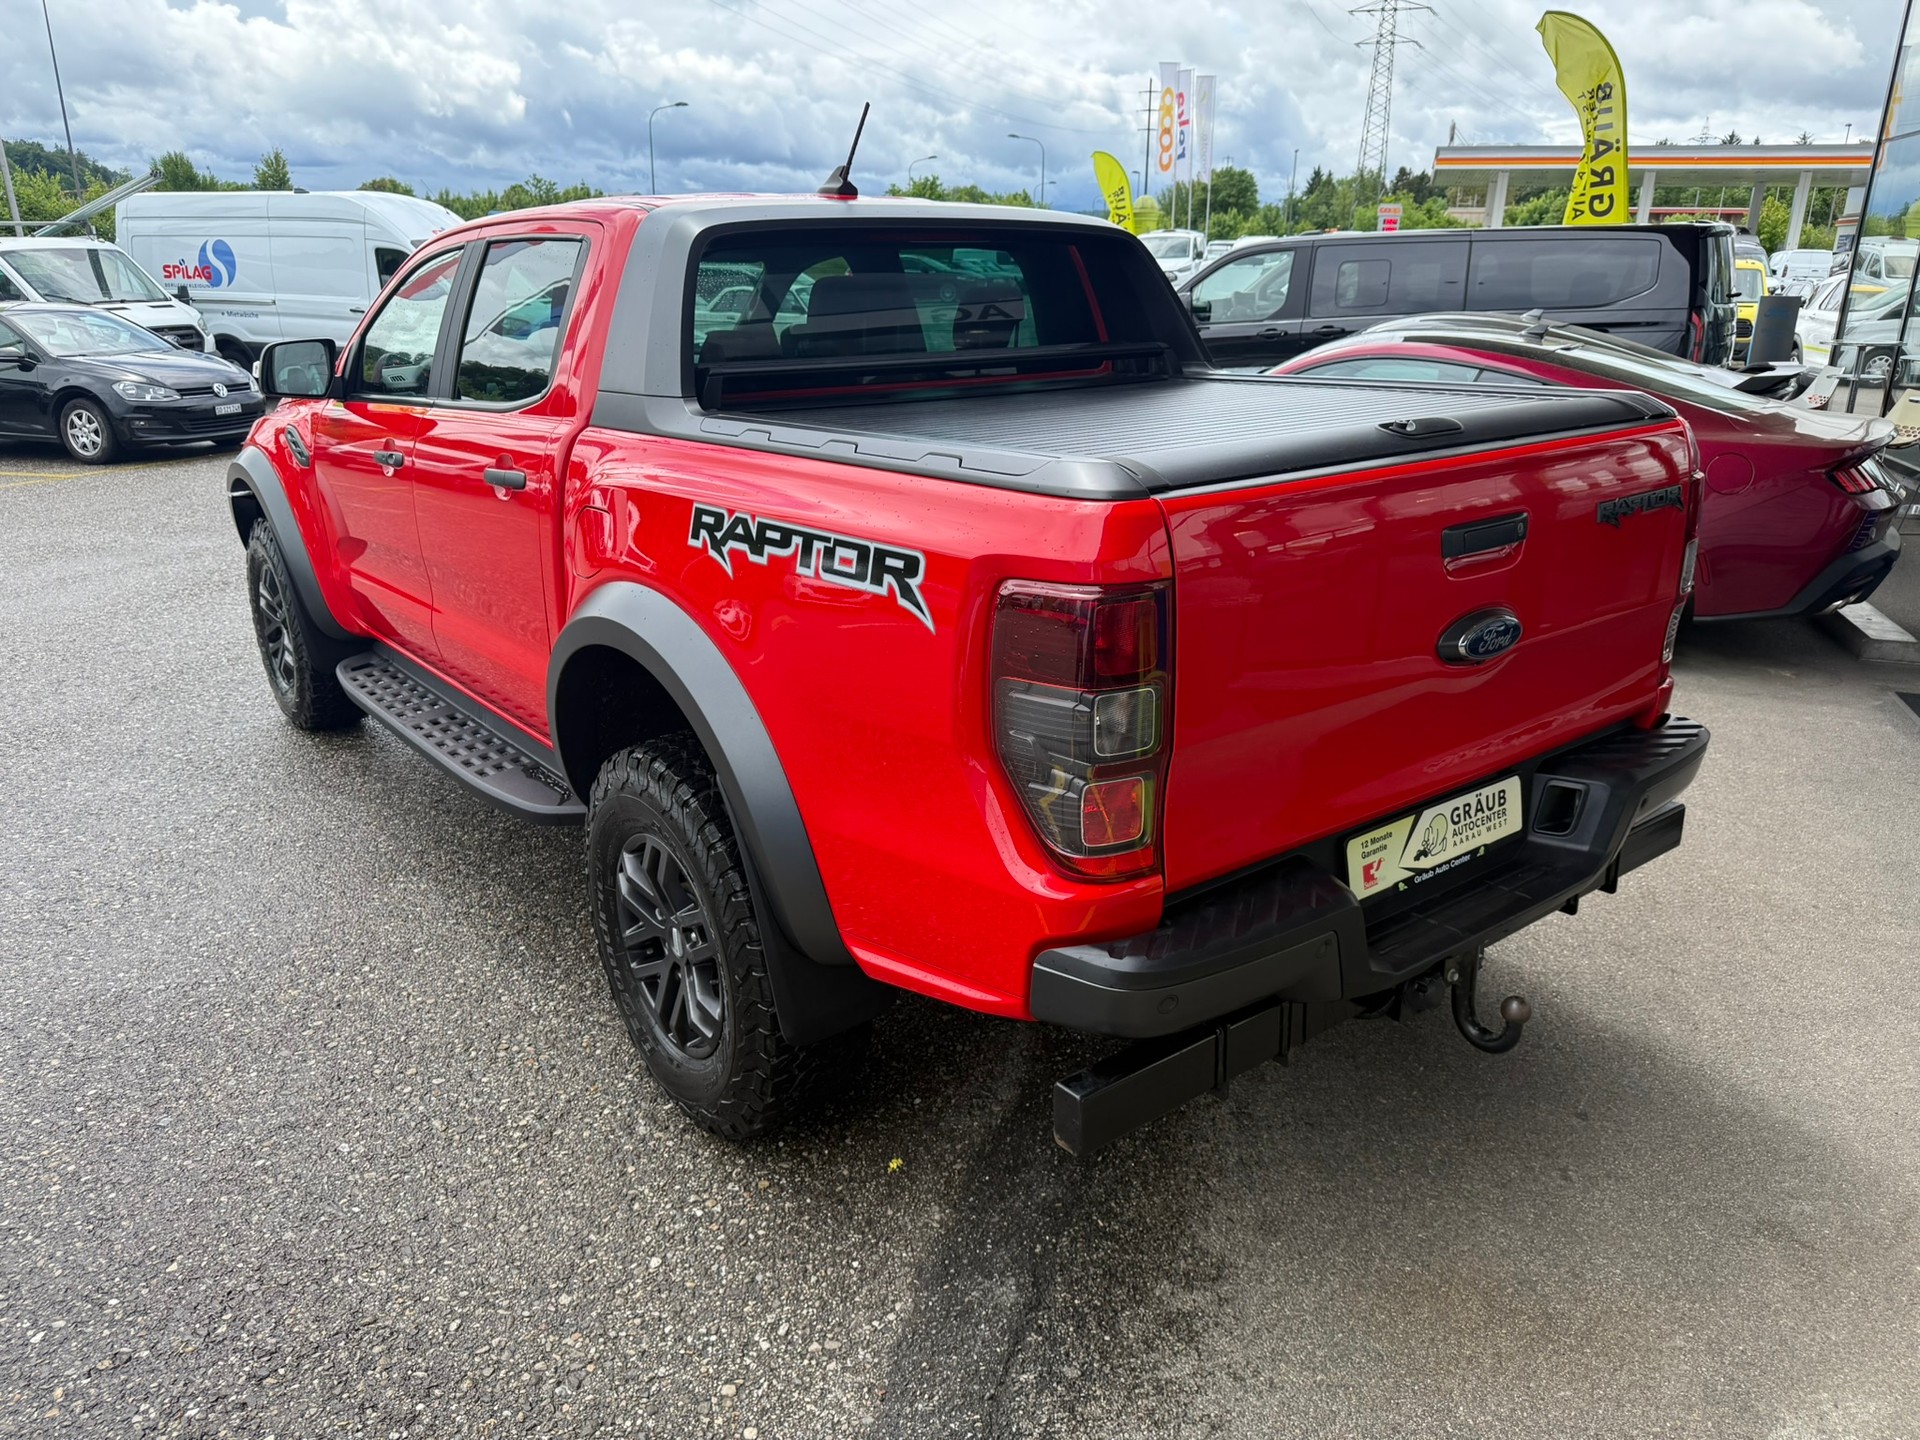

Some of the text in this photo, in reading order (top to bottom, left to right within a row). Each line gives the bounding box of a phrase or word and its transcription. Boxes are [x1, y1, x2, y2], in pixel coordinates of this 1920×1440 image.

[1597, 484, 1684, 528] RAPTOR
[687, 501, 936, 635] RAPTOR
[1478, 623, 1512, 654] Ford
[1450, 789, 1507, 826] GRÄUB
[1451, 807, 1507, 839] AUTOCENTER
[1361, 830, 1393, 850] 12 Monate
[1453, 818, 1508, 848] AARAU WEST
[1361, 844, 1388, 860] Garantie
[1414, 853, 1472, 884] Gräub Auto Center
